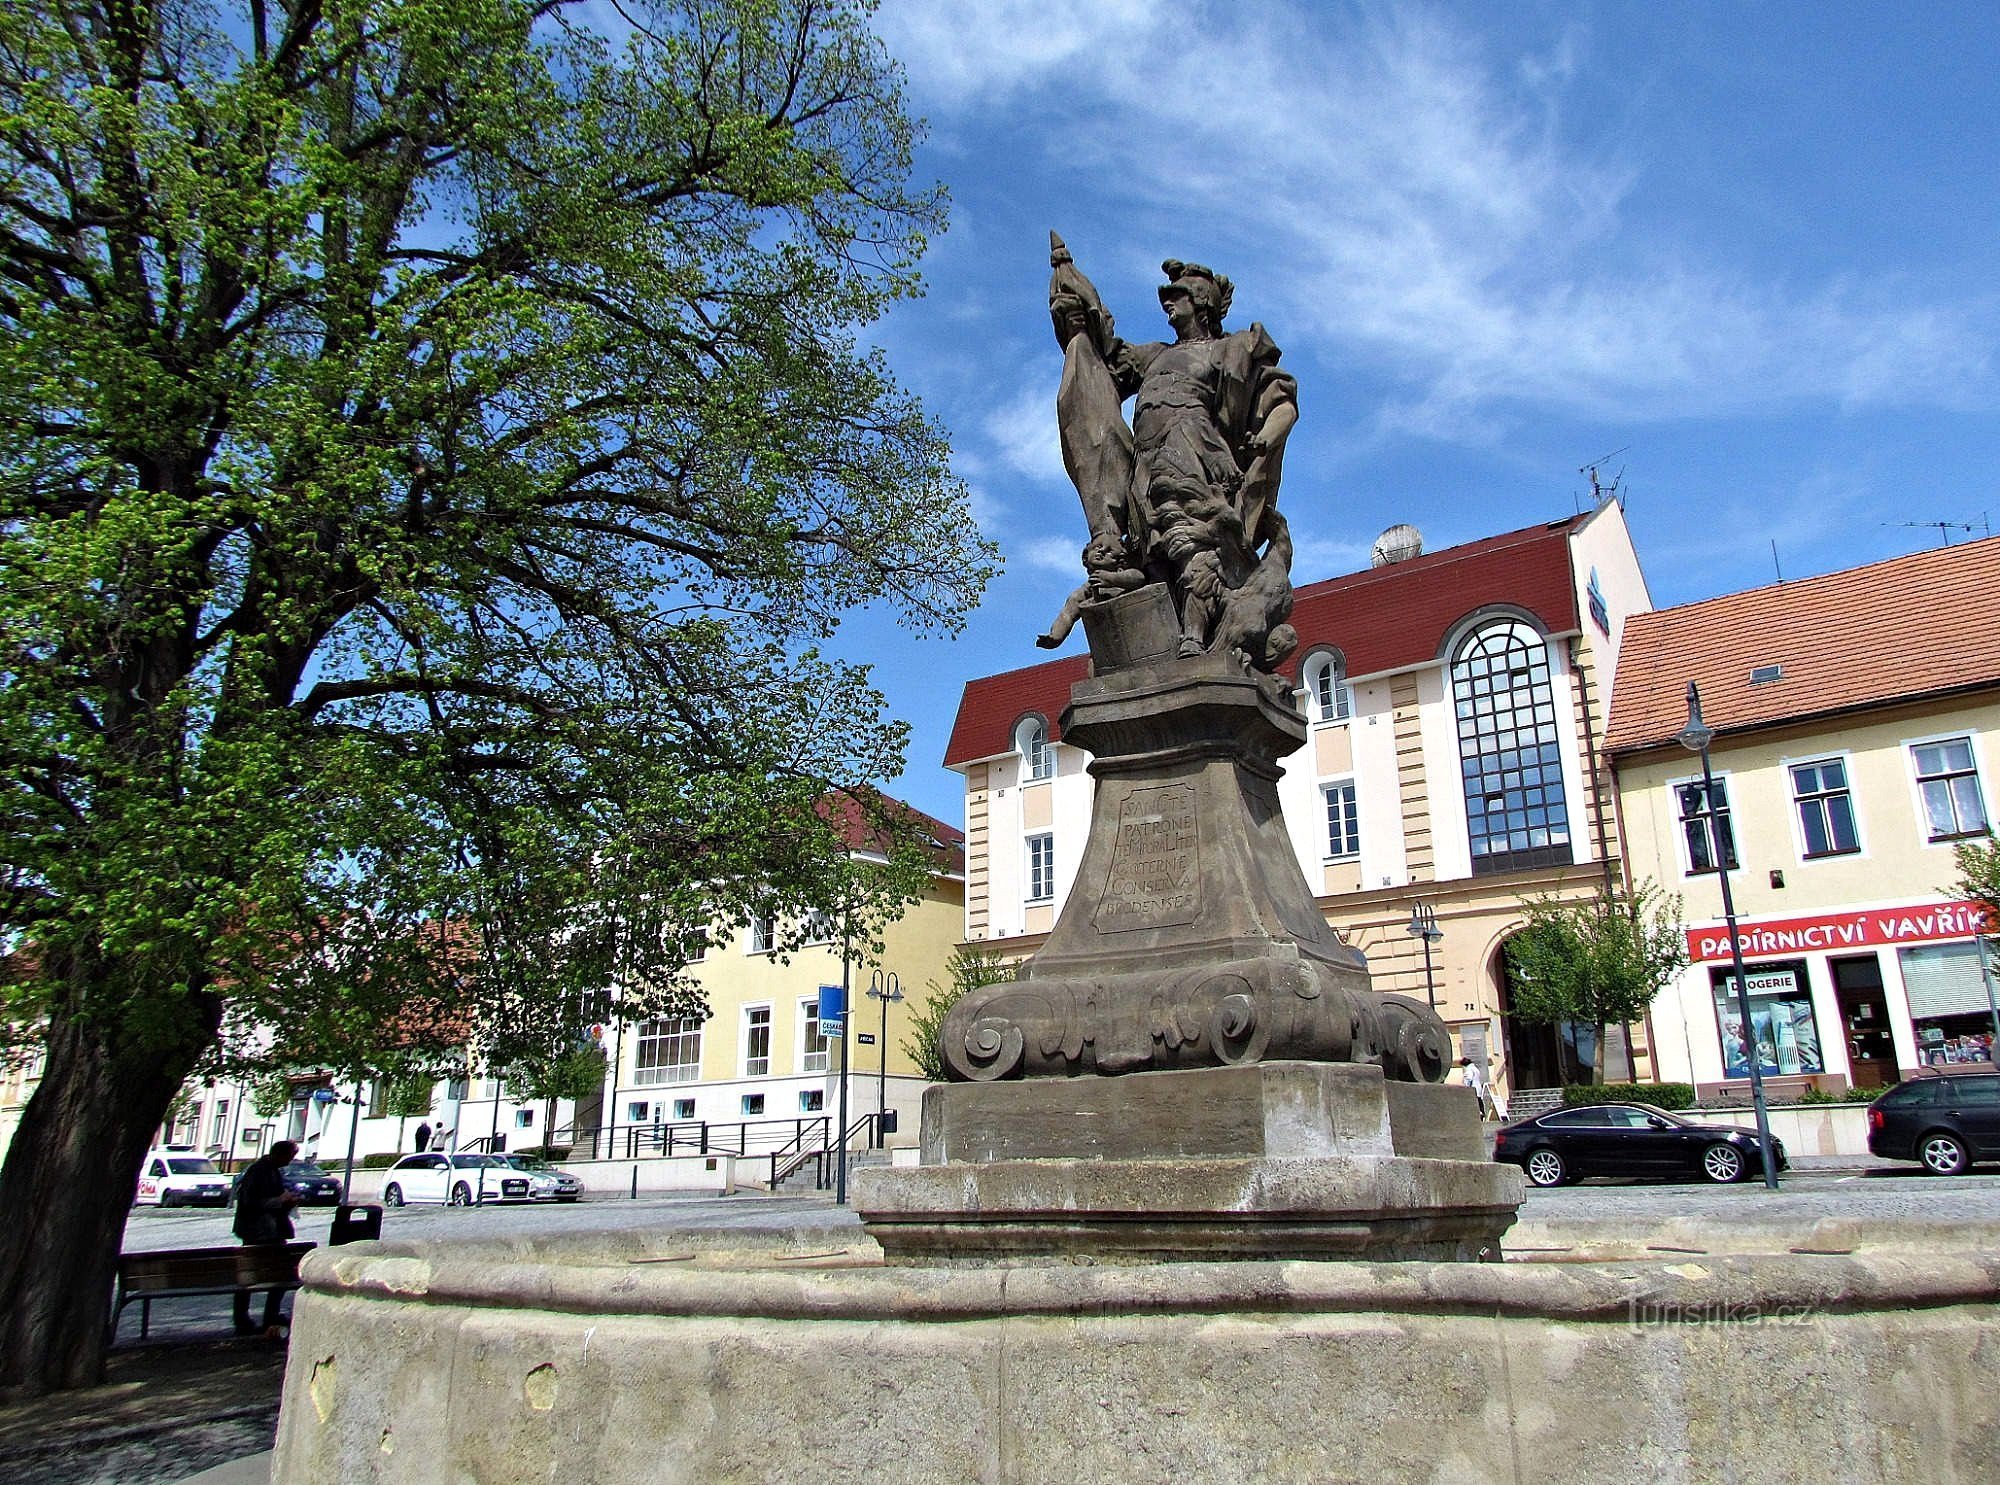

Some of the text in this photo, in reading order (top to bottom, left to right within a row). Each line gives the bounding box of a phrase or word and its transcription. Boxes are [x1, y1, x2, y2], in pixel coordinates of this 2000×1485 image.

[1124, 816, 1191, 839] PATRONE
[1701, 906, 1985, 957] PAPÍRNICTVÍ VAVŘÍK
[1731, 977, 1793, 992] DOGERIE
